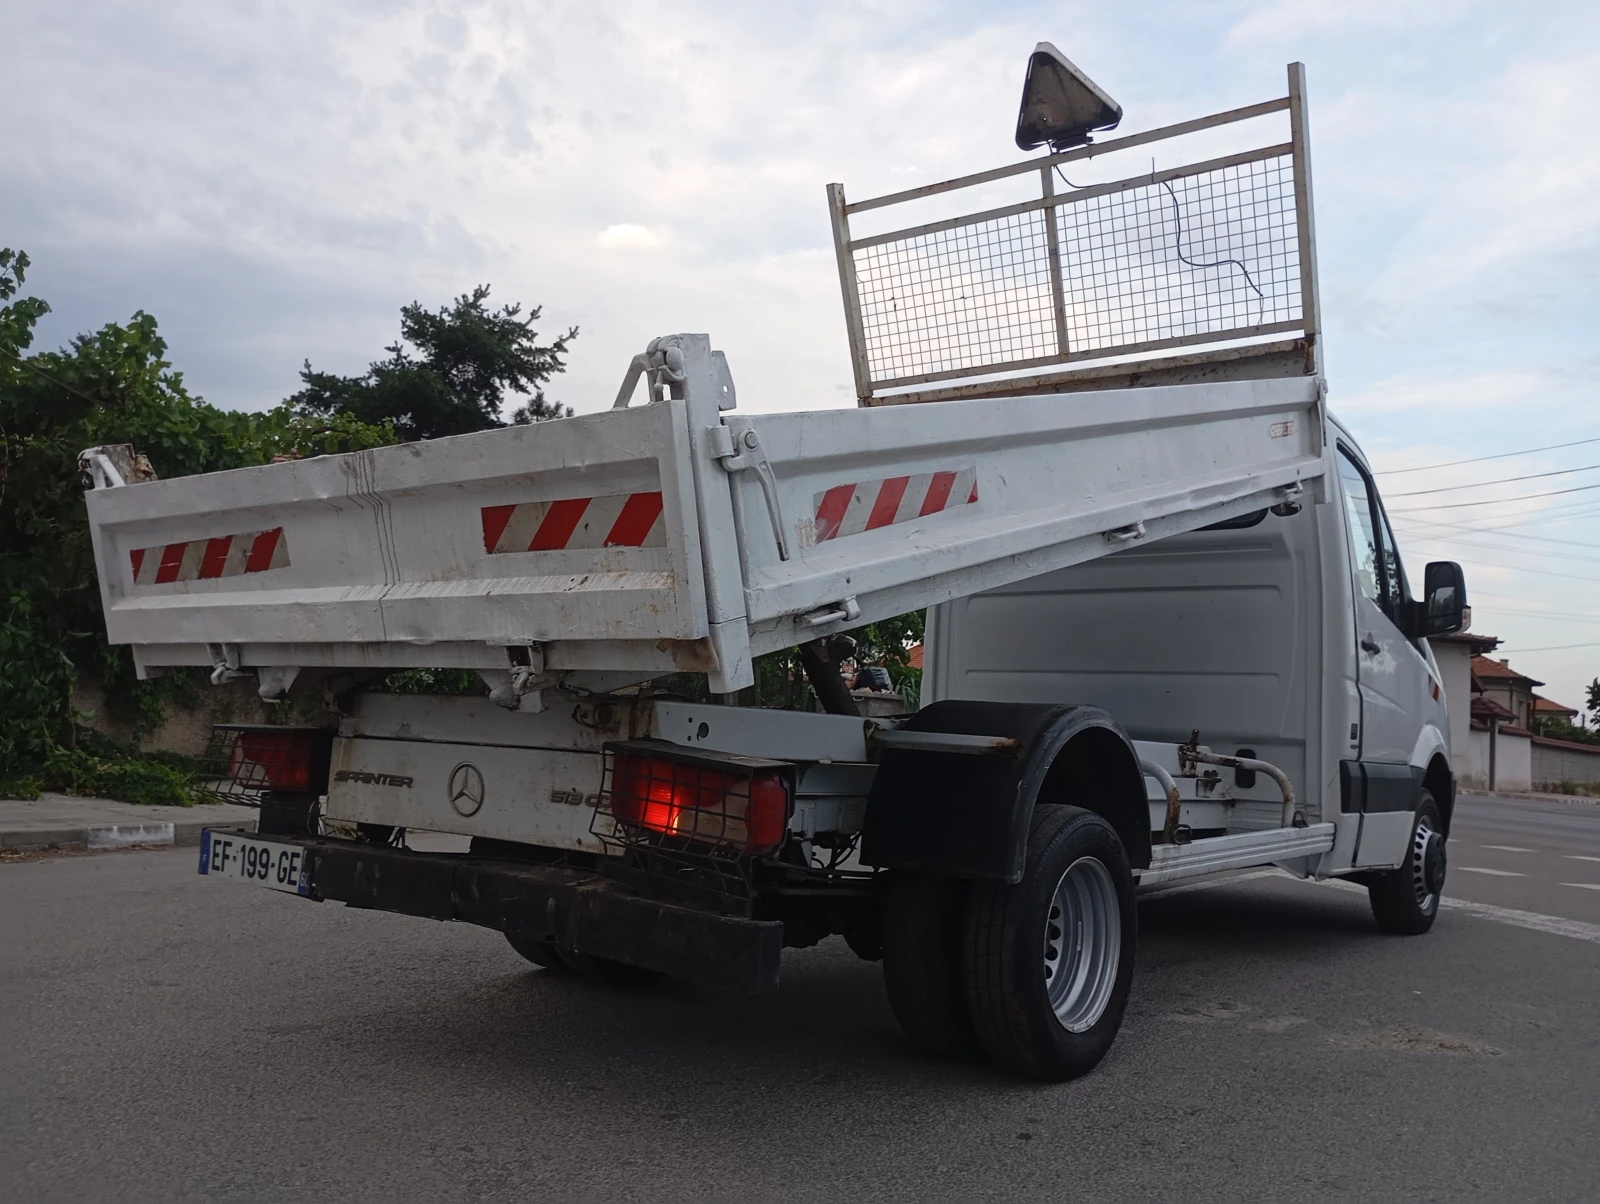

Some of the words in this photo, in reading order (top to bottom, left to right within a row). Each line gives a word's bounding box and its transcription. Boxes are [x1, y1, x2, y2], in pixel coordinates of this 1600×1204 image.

[334, 770, 414, 788] SPRINTER
[585, 793, 613, 808] CD
[211, 839, 301, 886] EF-199-GE
